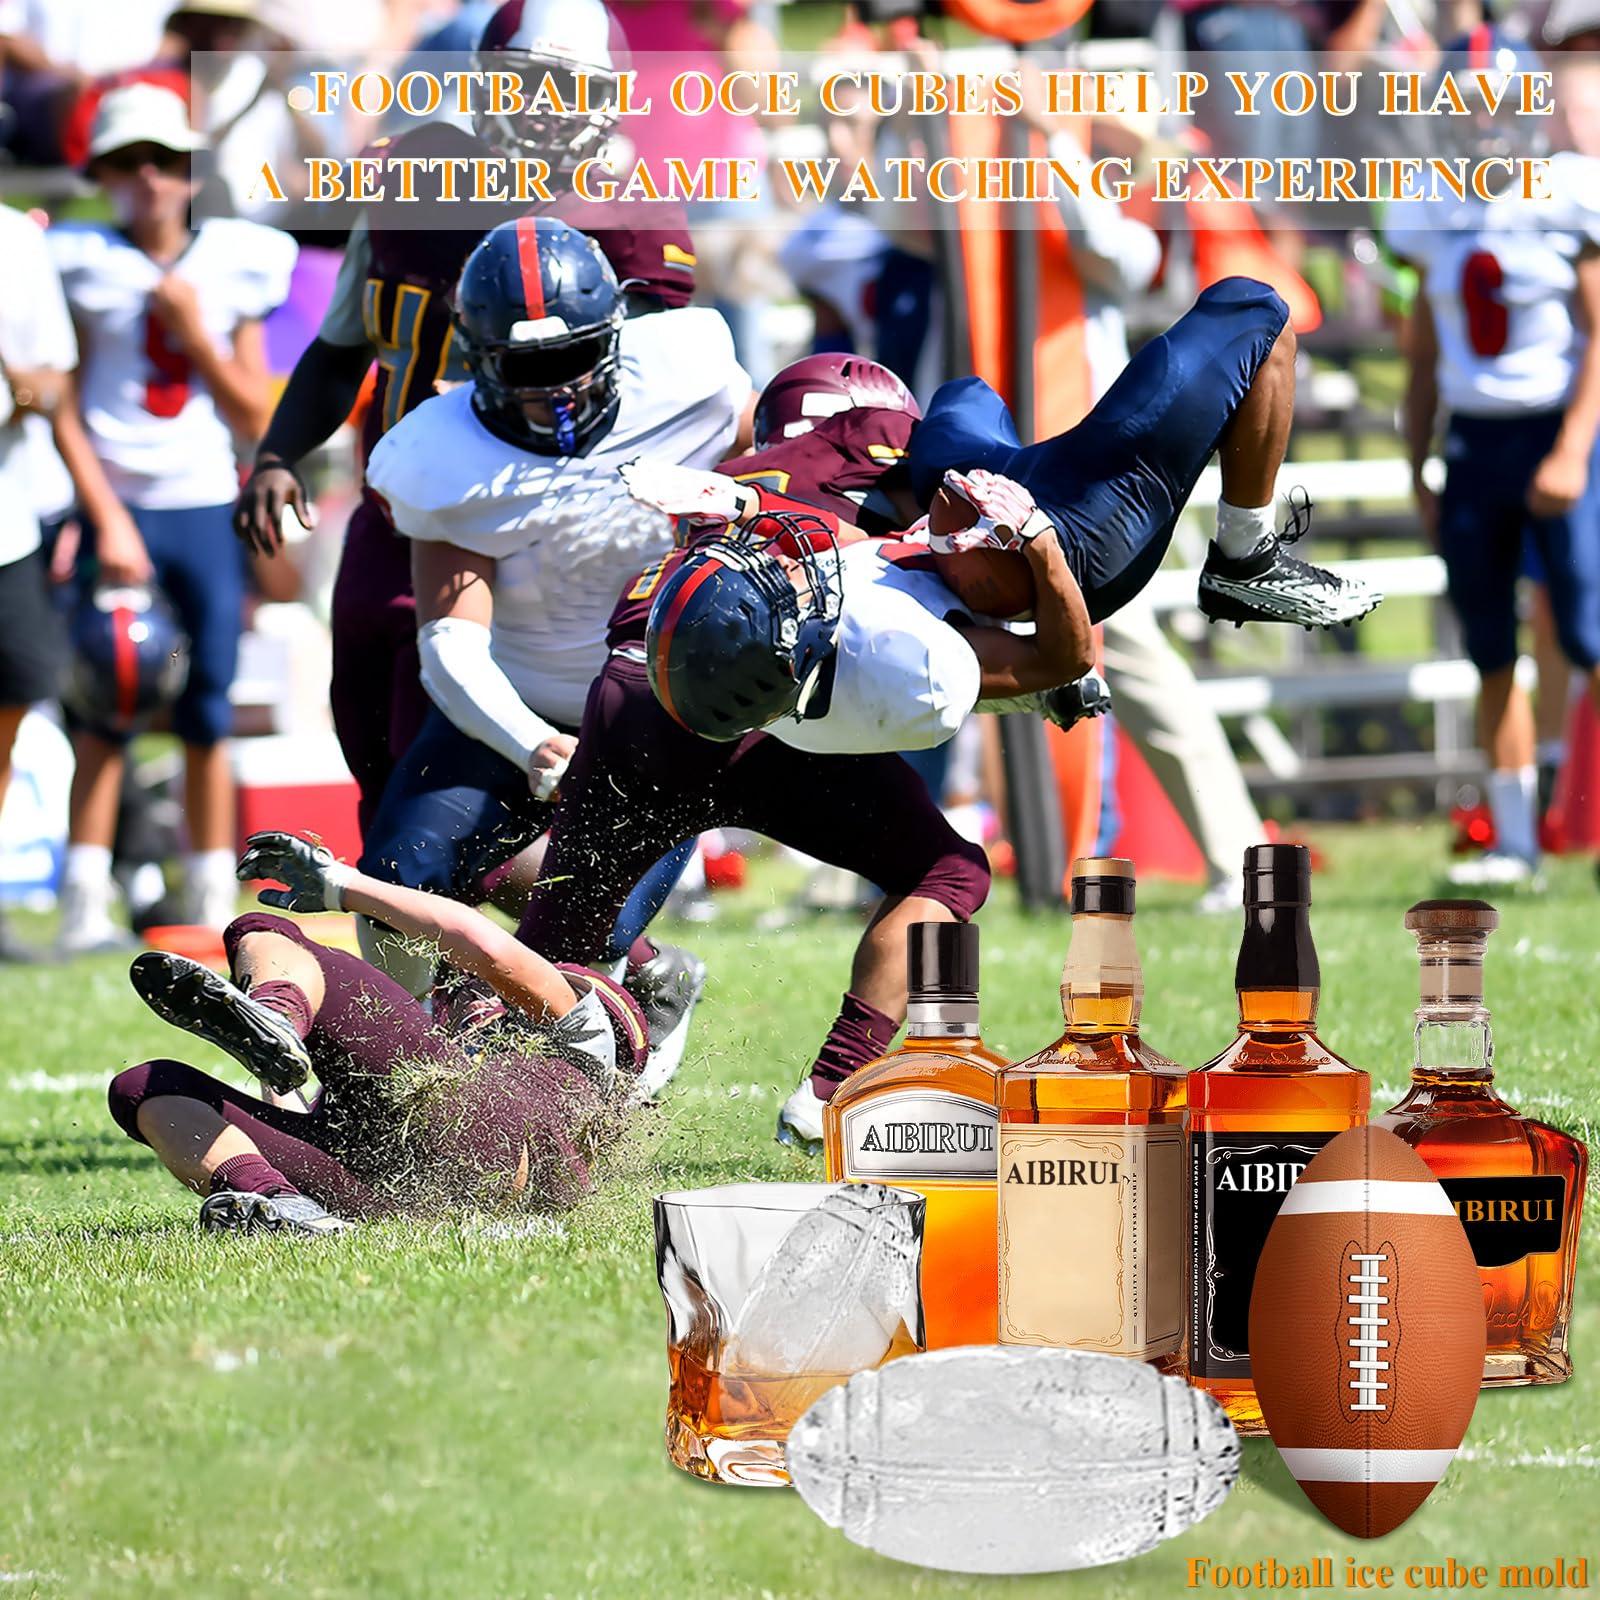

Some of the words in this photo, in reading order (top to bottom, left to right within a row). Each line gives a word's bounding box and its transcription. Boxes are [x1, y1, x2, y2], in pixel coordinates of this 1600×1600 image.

[860, 1122, 994, 1153] AIBIRUI
[1005, 1159, 1120, 1186] AIBIRUI
[1216, 1162, 1308, 1193] AIBI
[1454, 1199, 1557, 1223] IBIRUI
